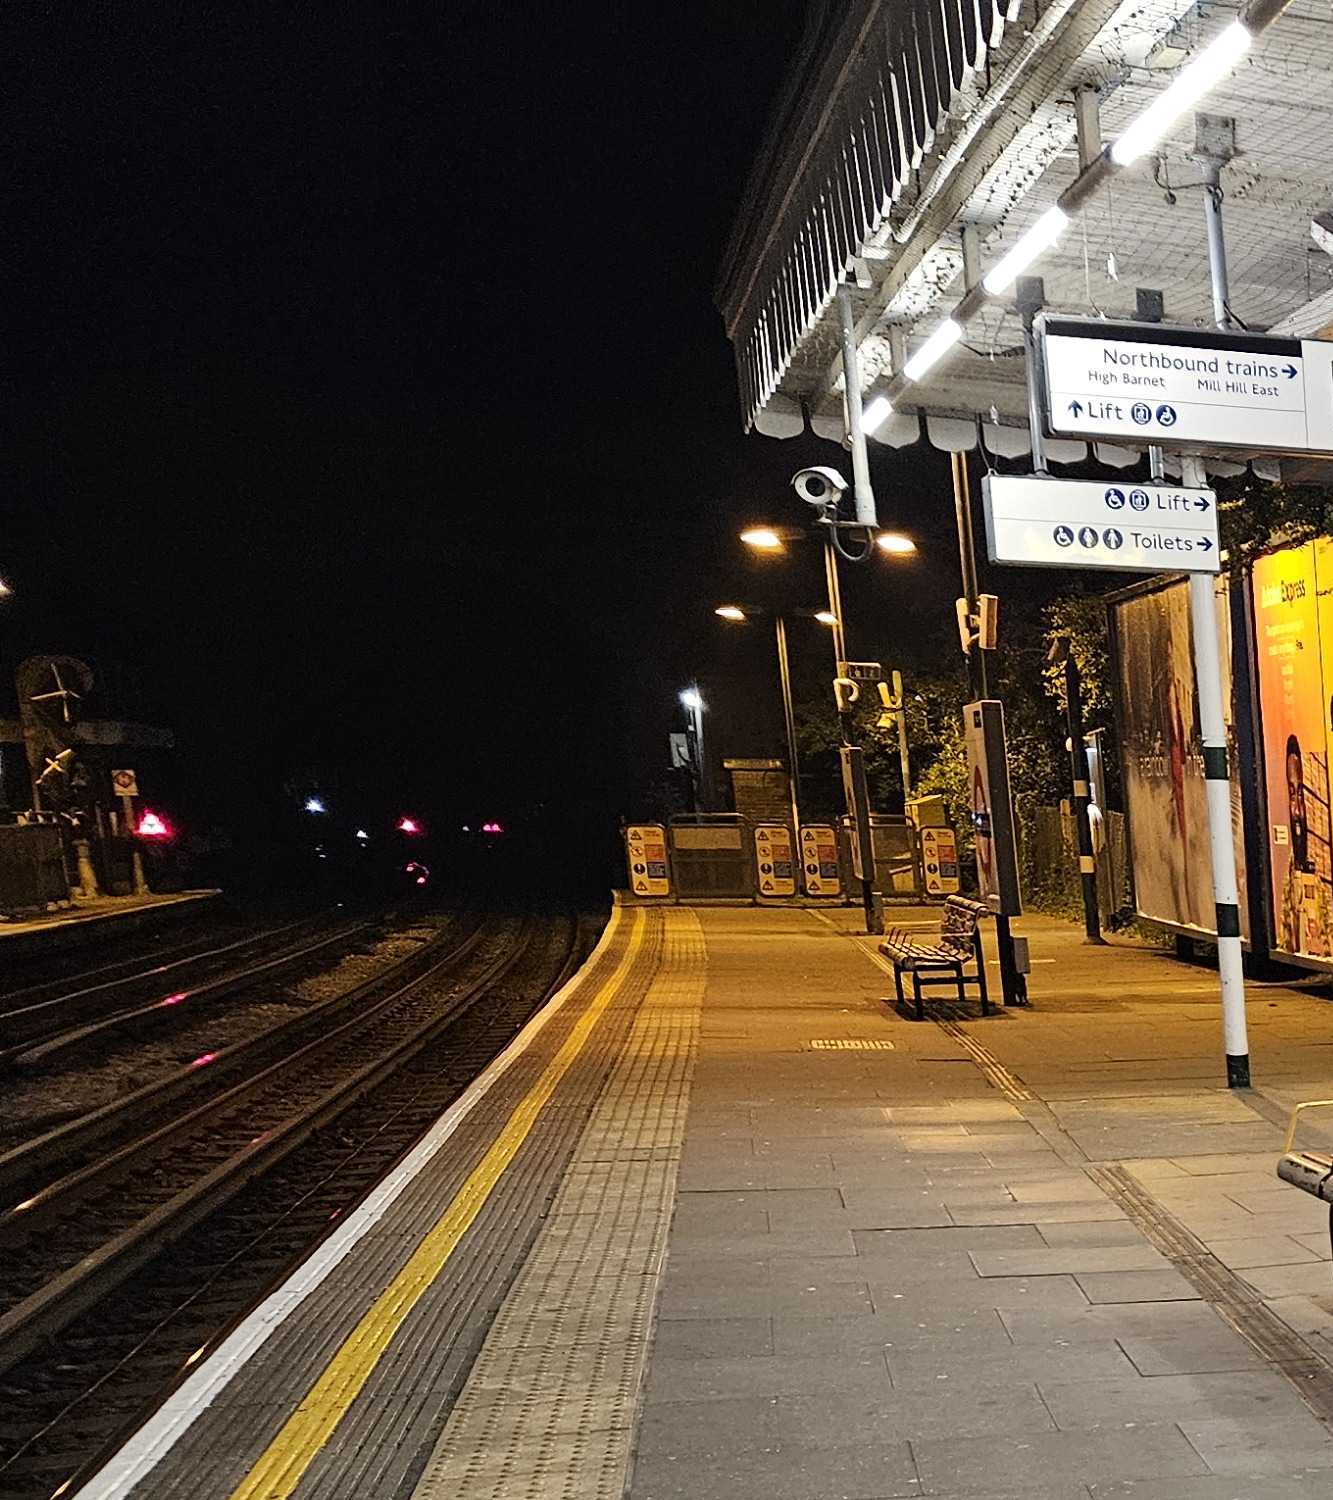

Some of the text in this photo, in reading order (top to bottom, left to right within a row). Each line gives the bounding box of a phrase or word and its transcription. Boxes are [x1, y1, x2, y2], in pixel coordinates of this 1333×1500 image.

[1103, 348, 1278, 379] Northbound trains
[1088, 370, 1166, 388] High Barnet
[1197, 378, 1280, 397] Mill Hill East
[1088, 401, 1123, 421] Lift
[1157, 493, 1190, 511] Lift
[1130, 532, 1193, 551] Toilets
